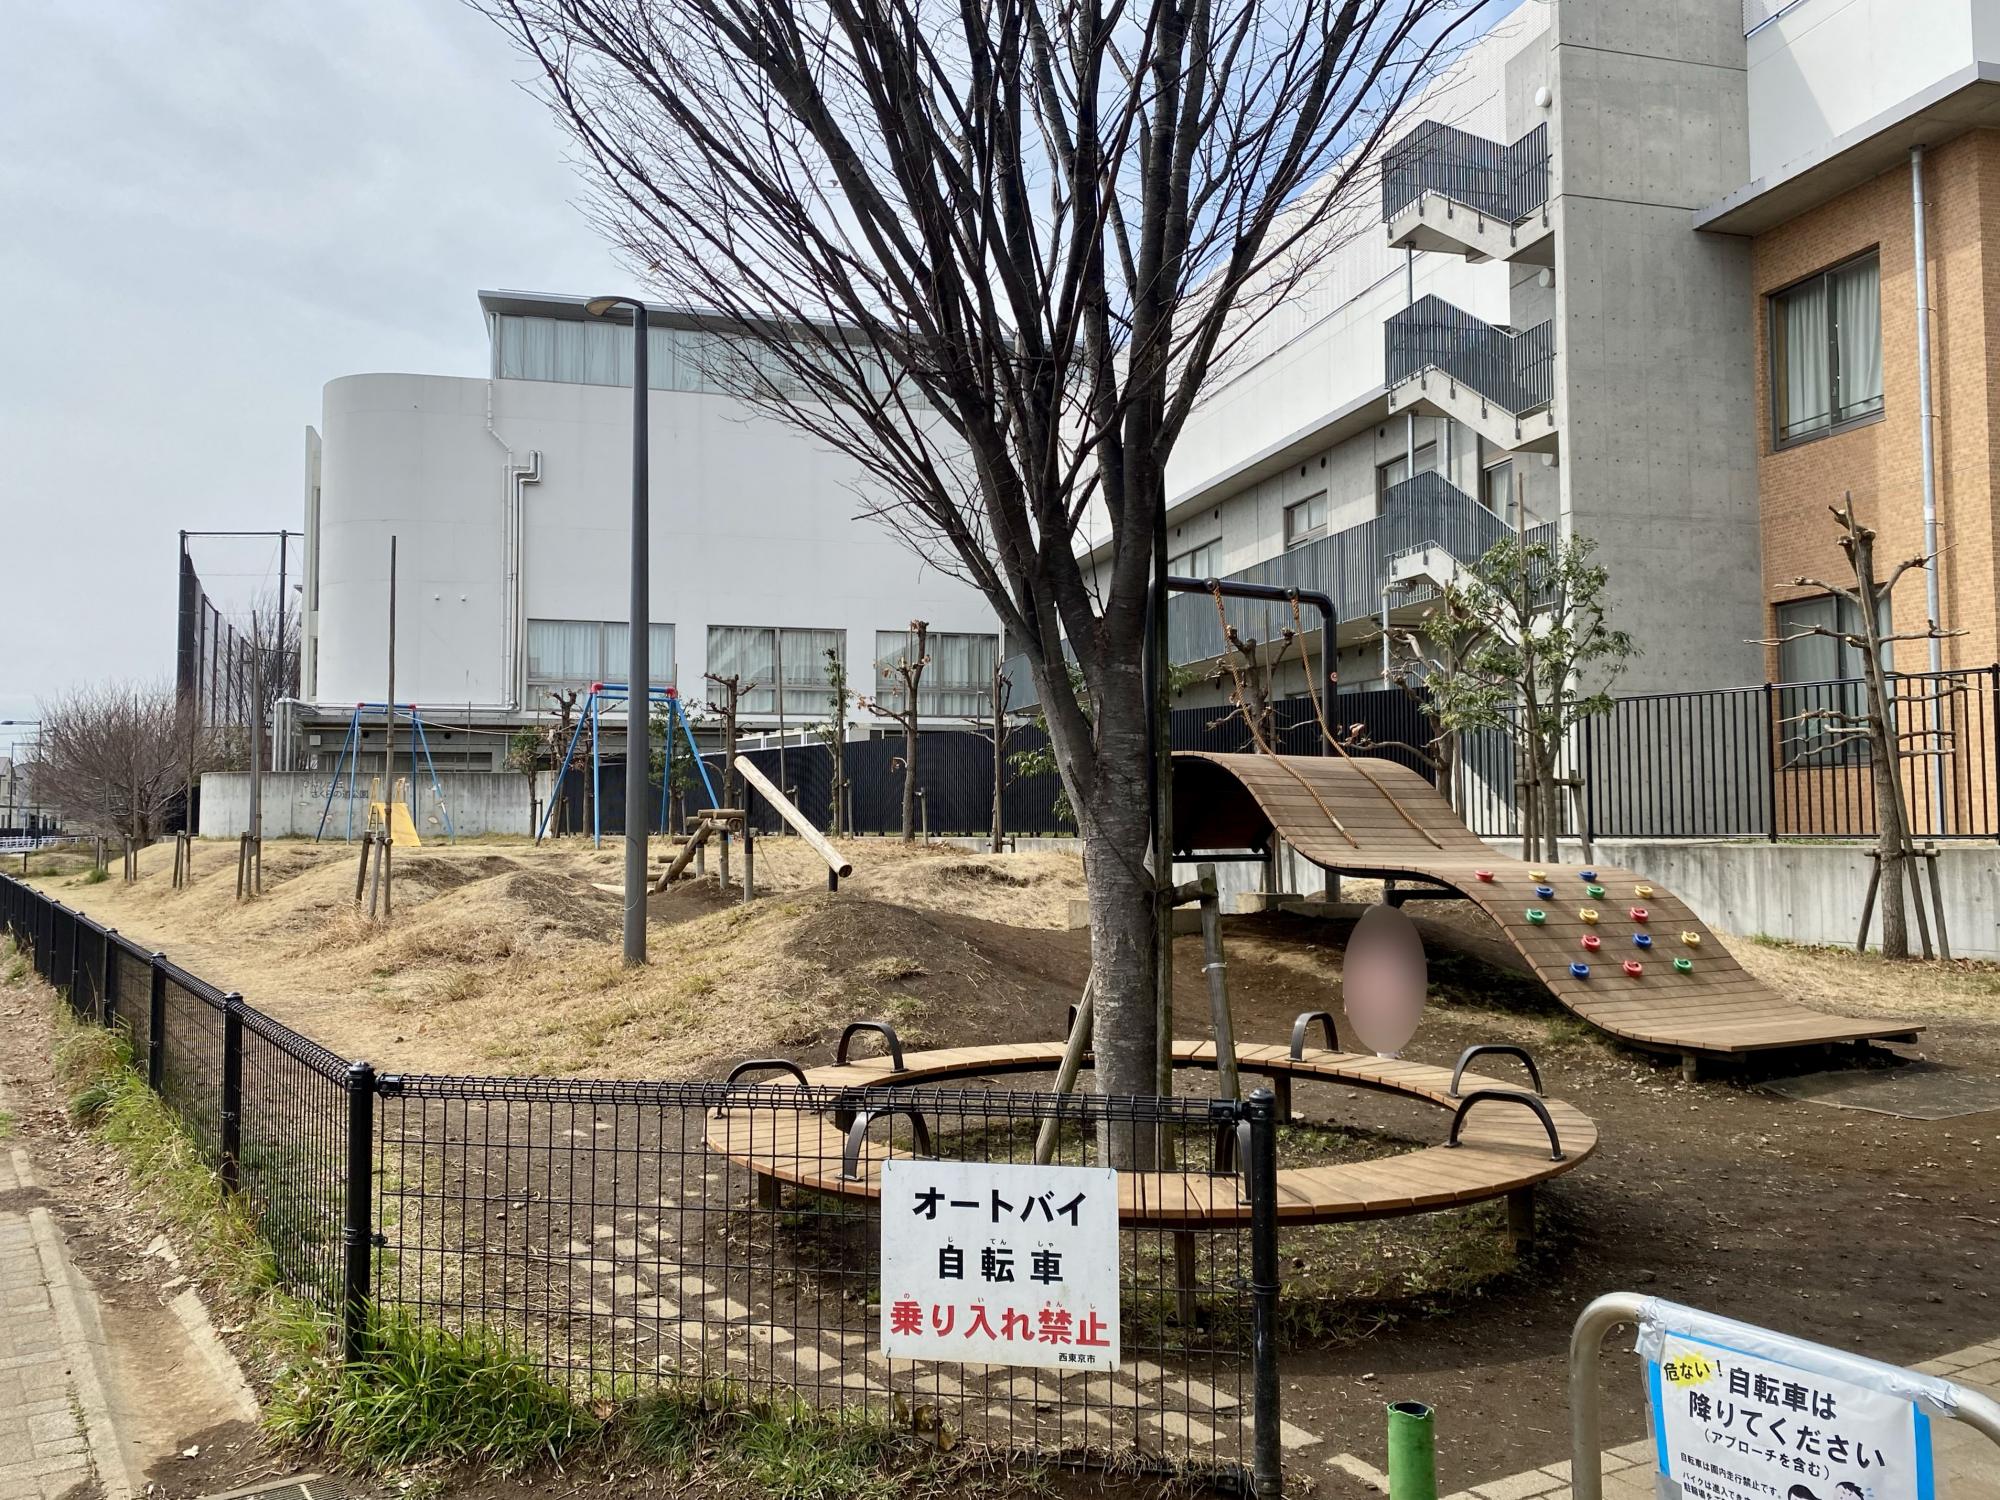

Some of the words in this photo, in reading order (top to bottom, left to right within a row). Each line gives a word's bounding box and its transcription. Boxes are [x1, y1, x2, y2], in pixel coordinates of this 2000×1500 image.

[912, 1186, 1086, 1226] オートバイ
[990, 1238, 1007, 1246] てん
[939, 1244, 1063, 1285] 自転車
[890, 1300, 1111, 1347] 乗り入れ禁止
[1058, 1352, 1096, 1364] 西東京市
[1729, 1367, 1837, 1420] 自転車は
[1689, 1390, 1886, 1469] 降りてください
